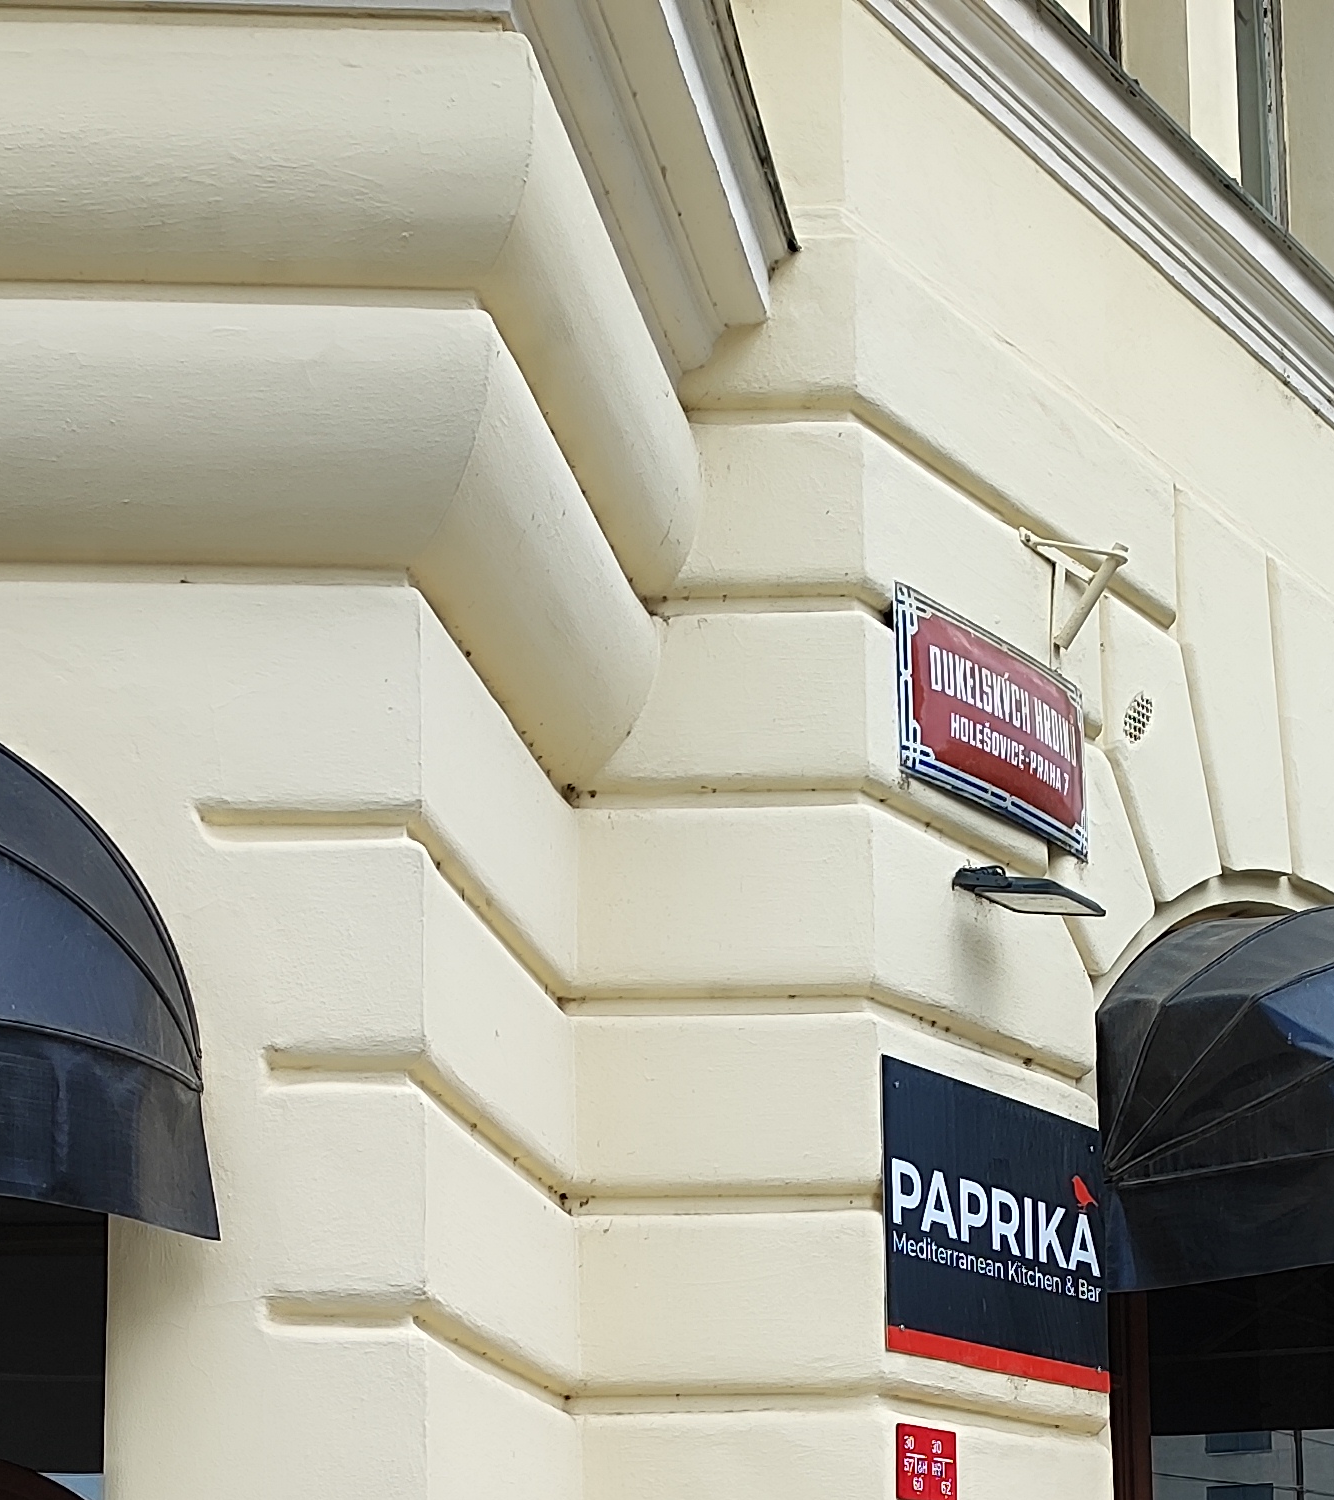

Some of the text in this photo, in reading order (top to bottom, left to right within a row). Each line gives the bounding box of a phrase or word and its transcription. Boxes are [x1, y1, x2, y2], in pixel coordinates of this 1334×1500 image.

[929, 644, 1077, 768] DUKELSKÝCH HRDINŮ
[1063, 772, 1069, 797] 7
[891, 1156, 1101, 1278] PAPRIKA
[892, 1230, 1102, 1303] Mediterranean Kitchen & Bar
